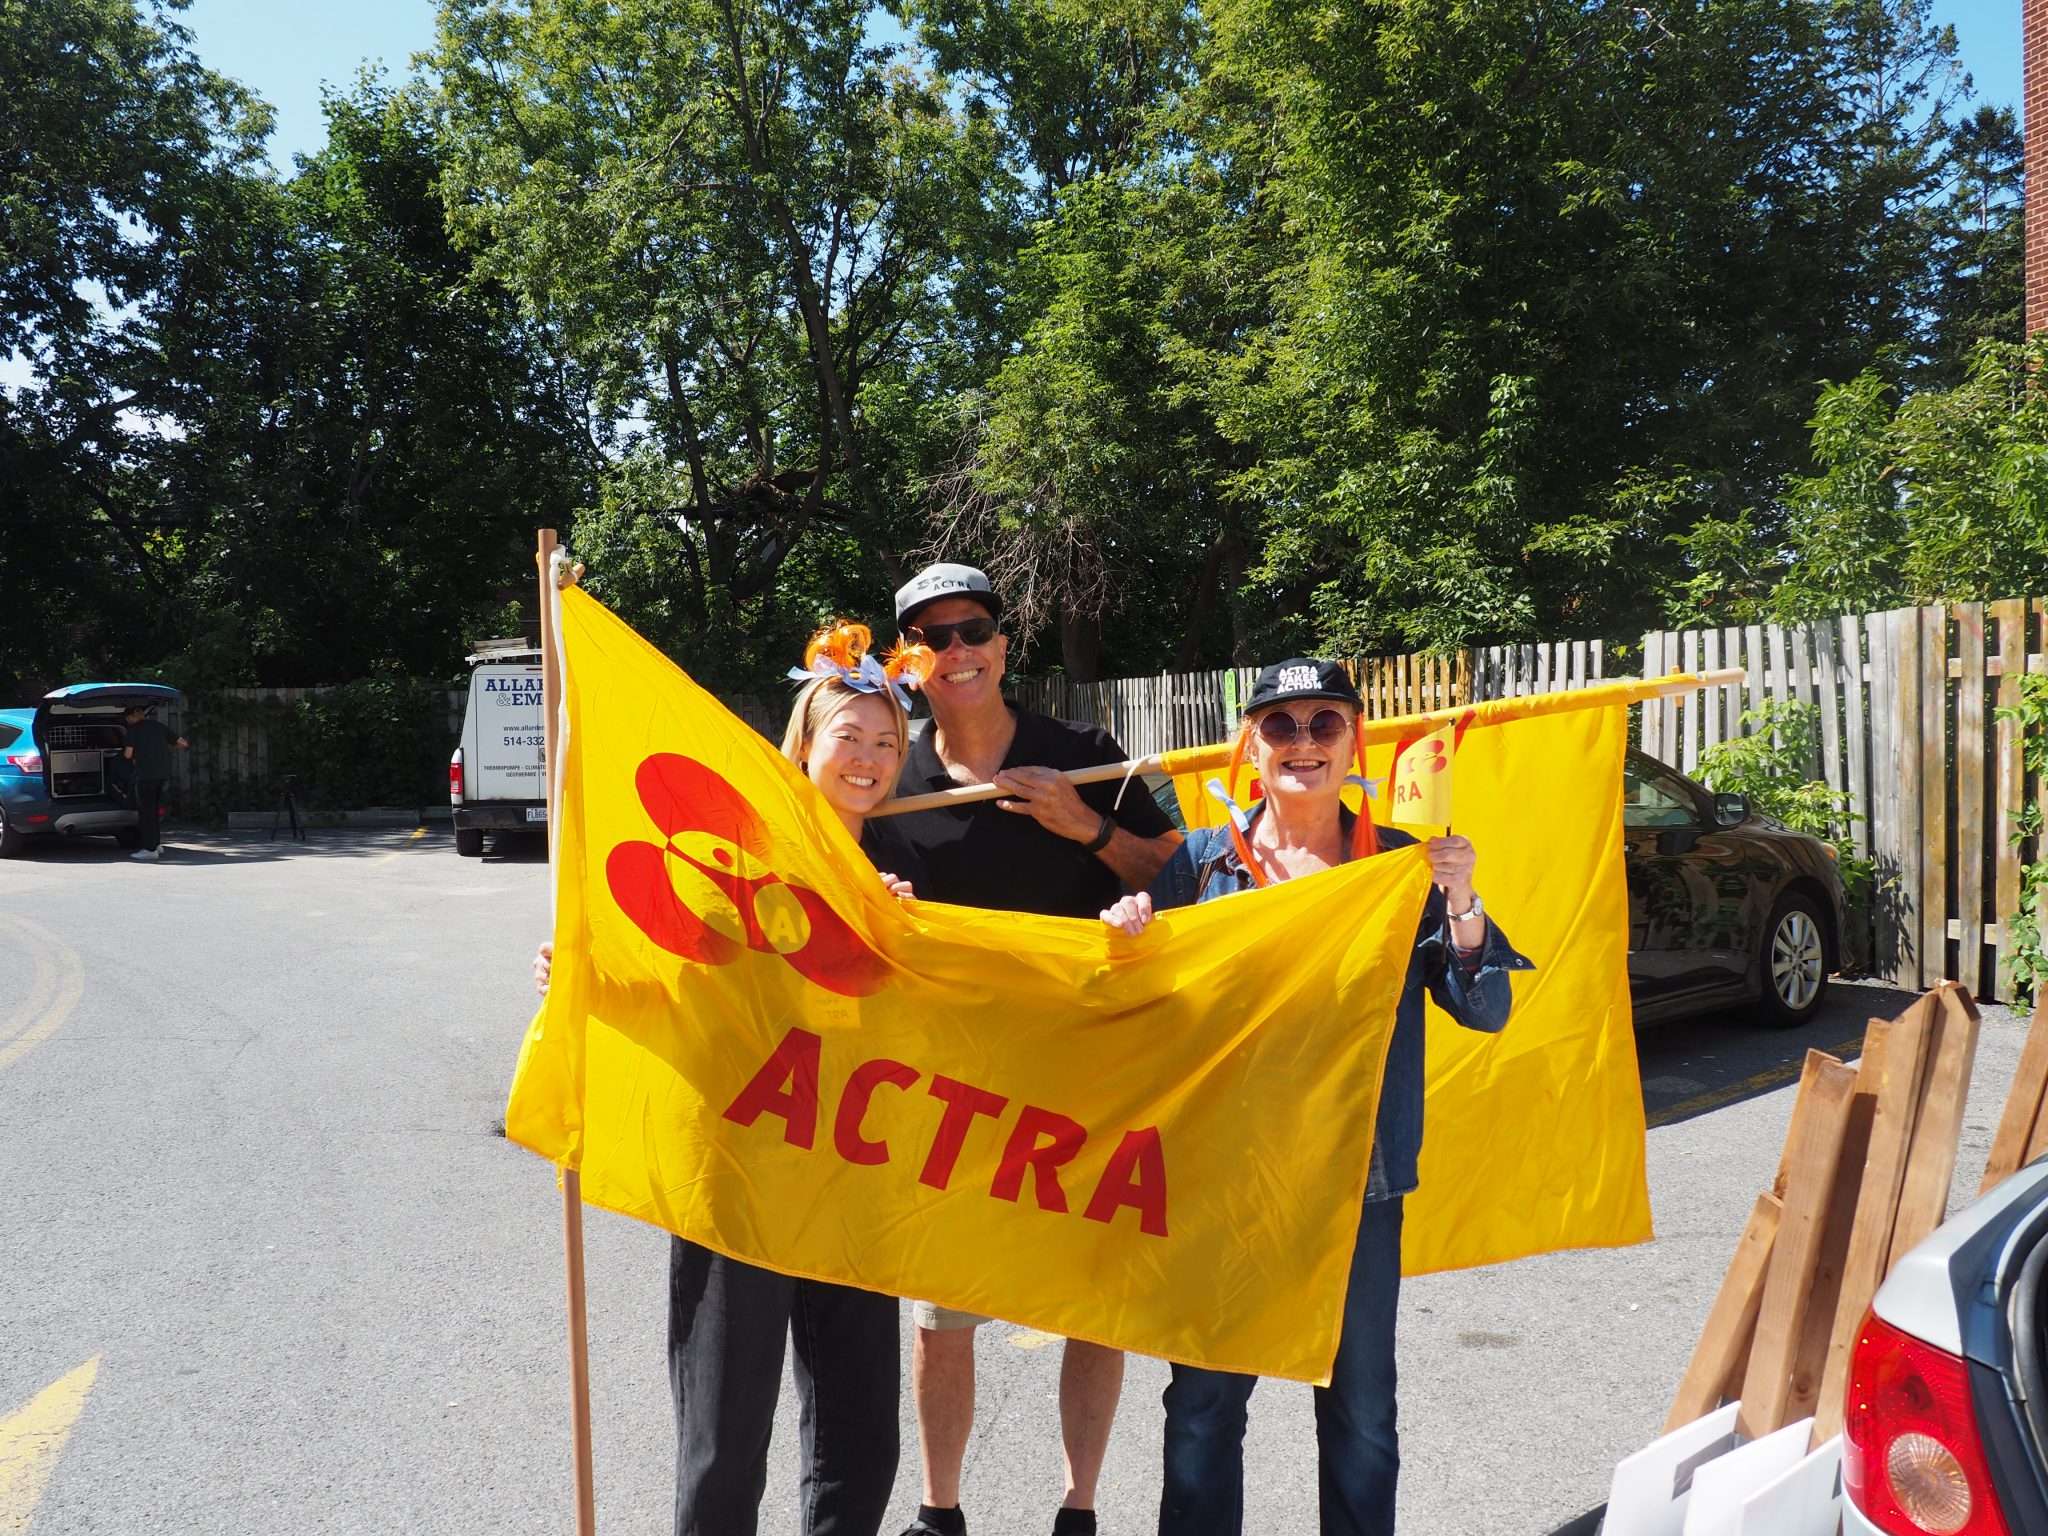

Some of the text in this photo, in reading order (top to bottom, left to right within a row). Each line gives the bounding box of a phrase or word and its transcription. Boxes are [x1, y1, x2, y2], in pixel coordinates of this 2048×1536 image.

[934, 581, 972, 590] ACTRA
[1279, 666, 1318, 678] ACTRA
[1279, 673, 1319, 684] TAKES
[1276, 680, 1322, 694] ACTION
[1394, 781, 1422, 805] RA
[722, 1026, 1168, 1238] ACTRA
